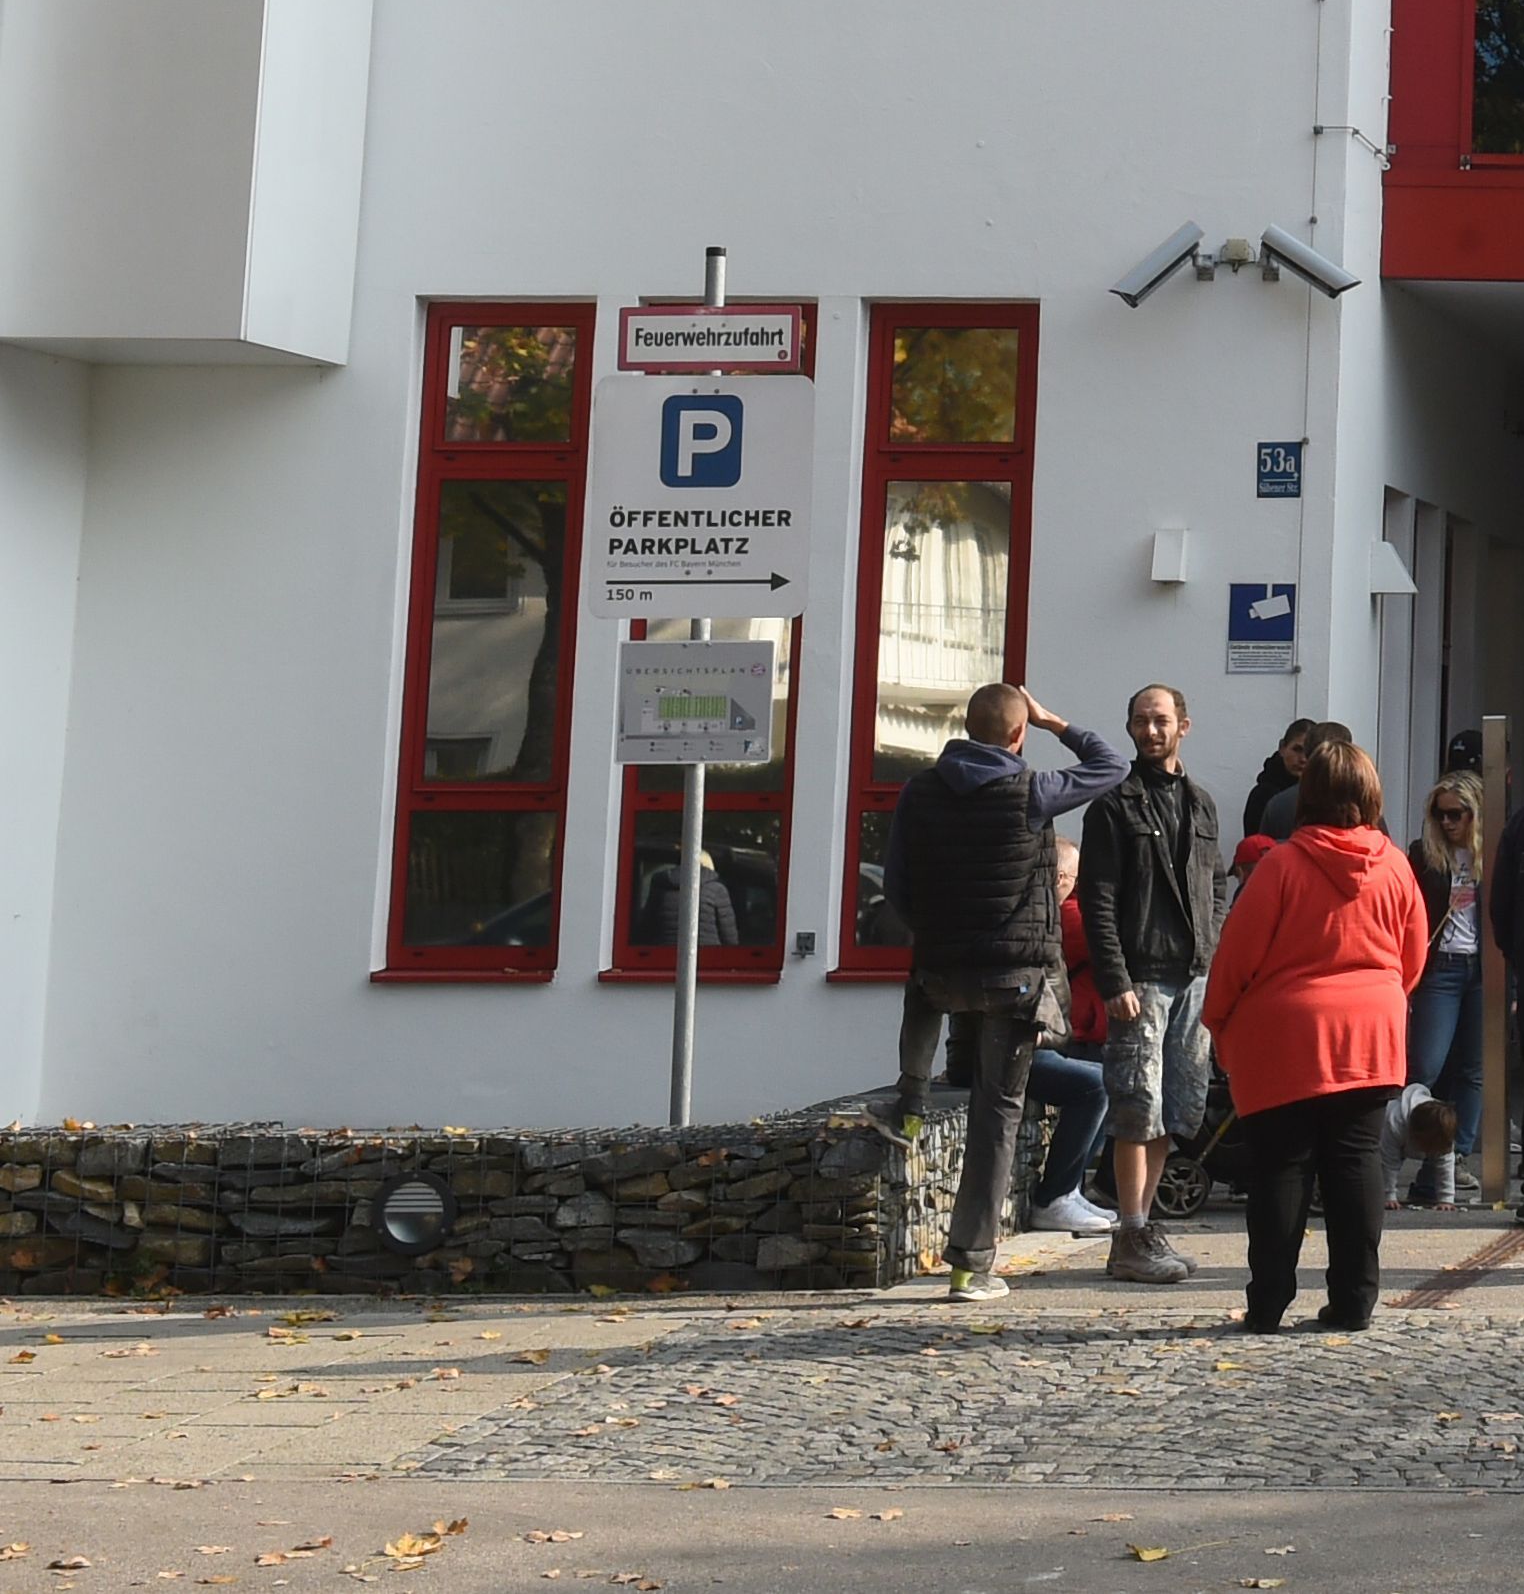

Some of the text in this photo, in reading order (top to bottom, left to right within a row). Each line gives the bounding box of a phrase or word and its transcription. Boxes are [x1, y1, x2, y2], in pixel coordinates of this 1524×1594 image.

[635, 327, 785, 347] Feuerwehrzufahrt
[676, 409, 732, 477] P
[1260, 447, 1296, 473] 53a
[609, 505, 792, 527] ÖFFENTLICHER
[609, 537, 750, 555] PARKPLATZ
[607, 559, 741, 569] für Besucher des FC Bayern München
[606, 589, 653, 601] 150 m
